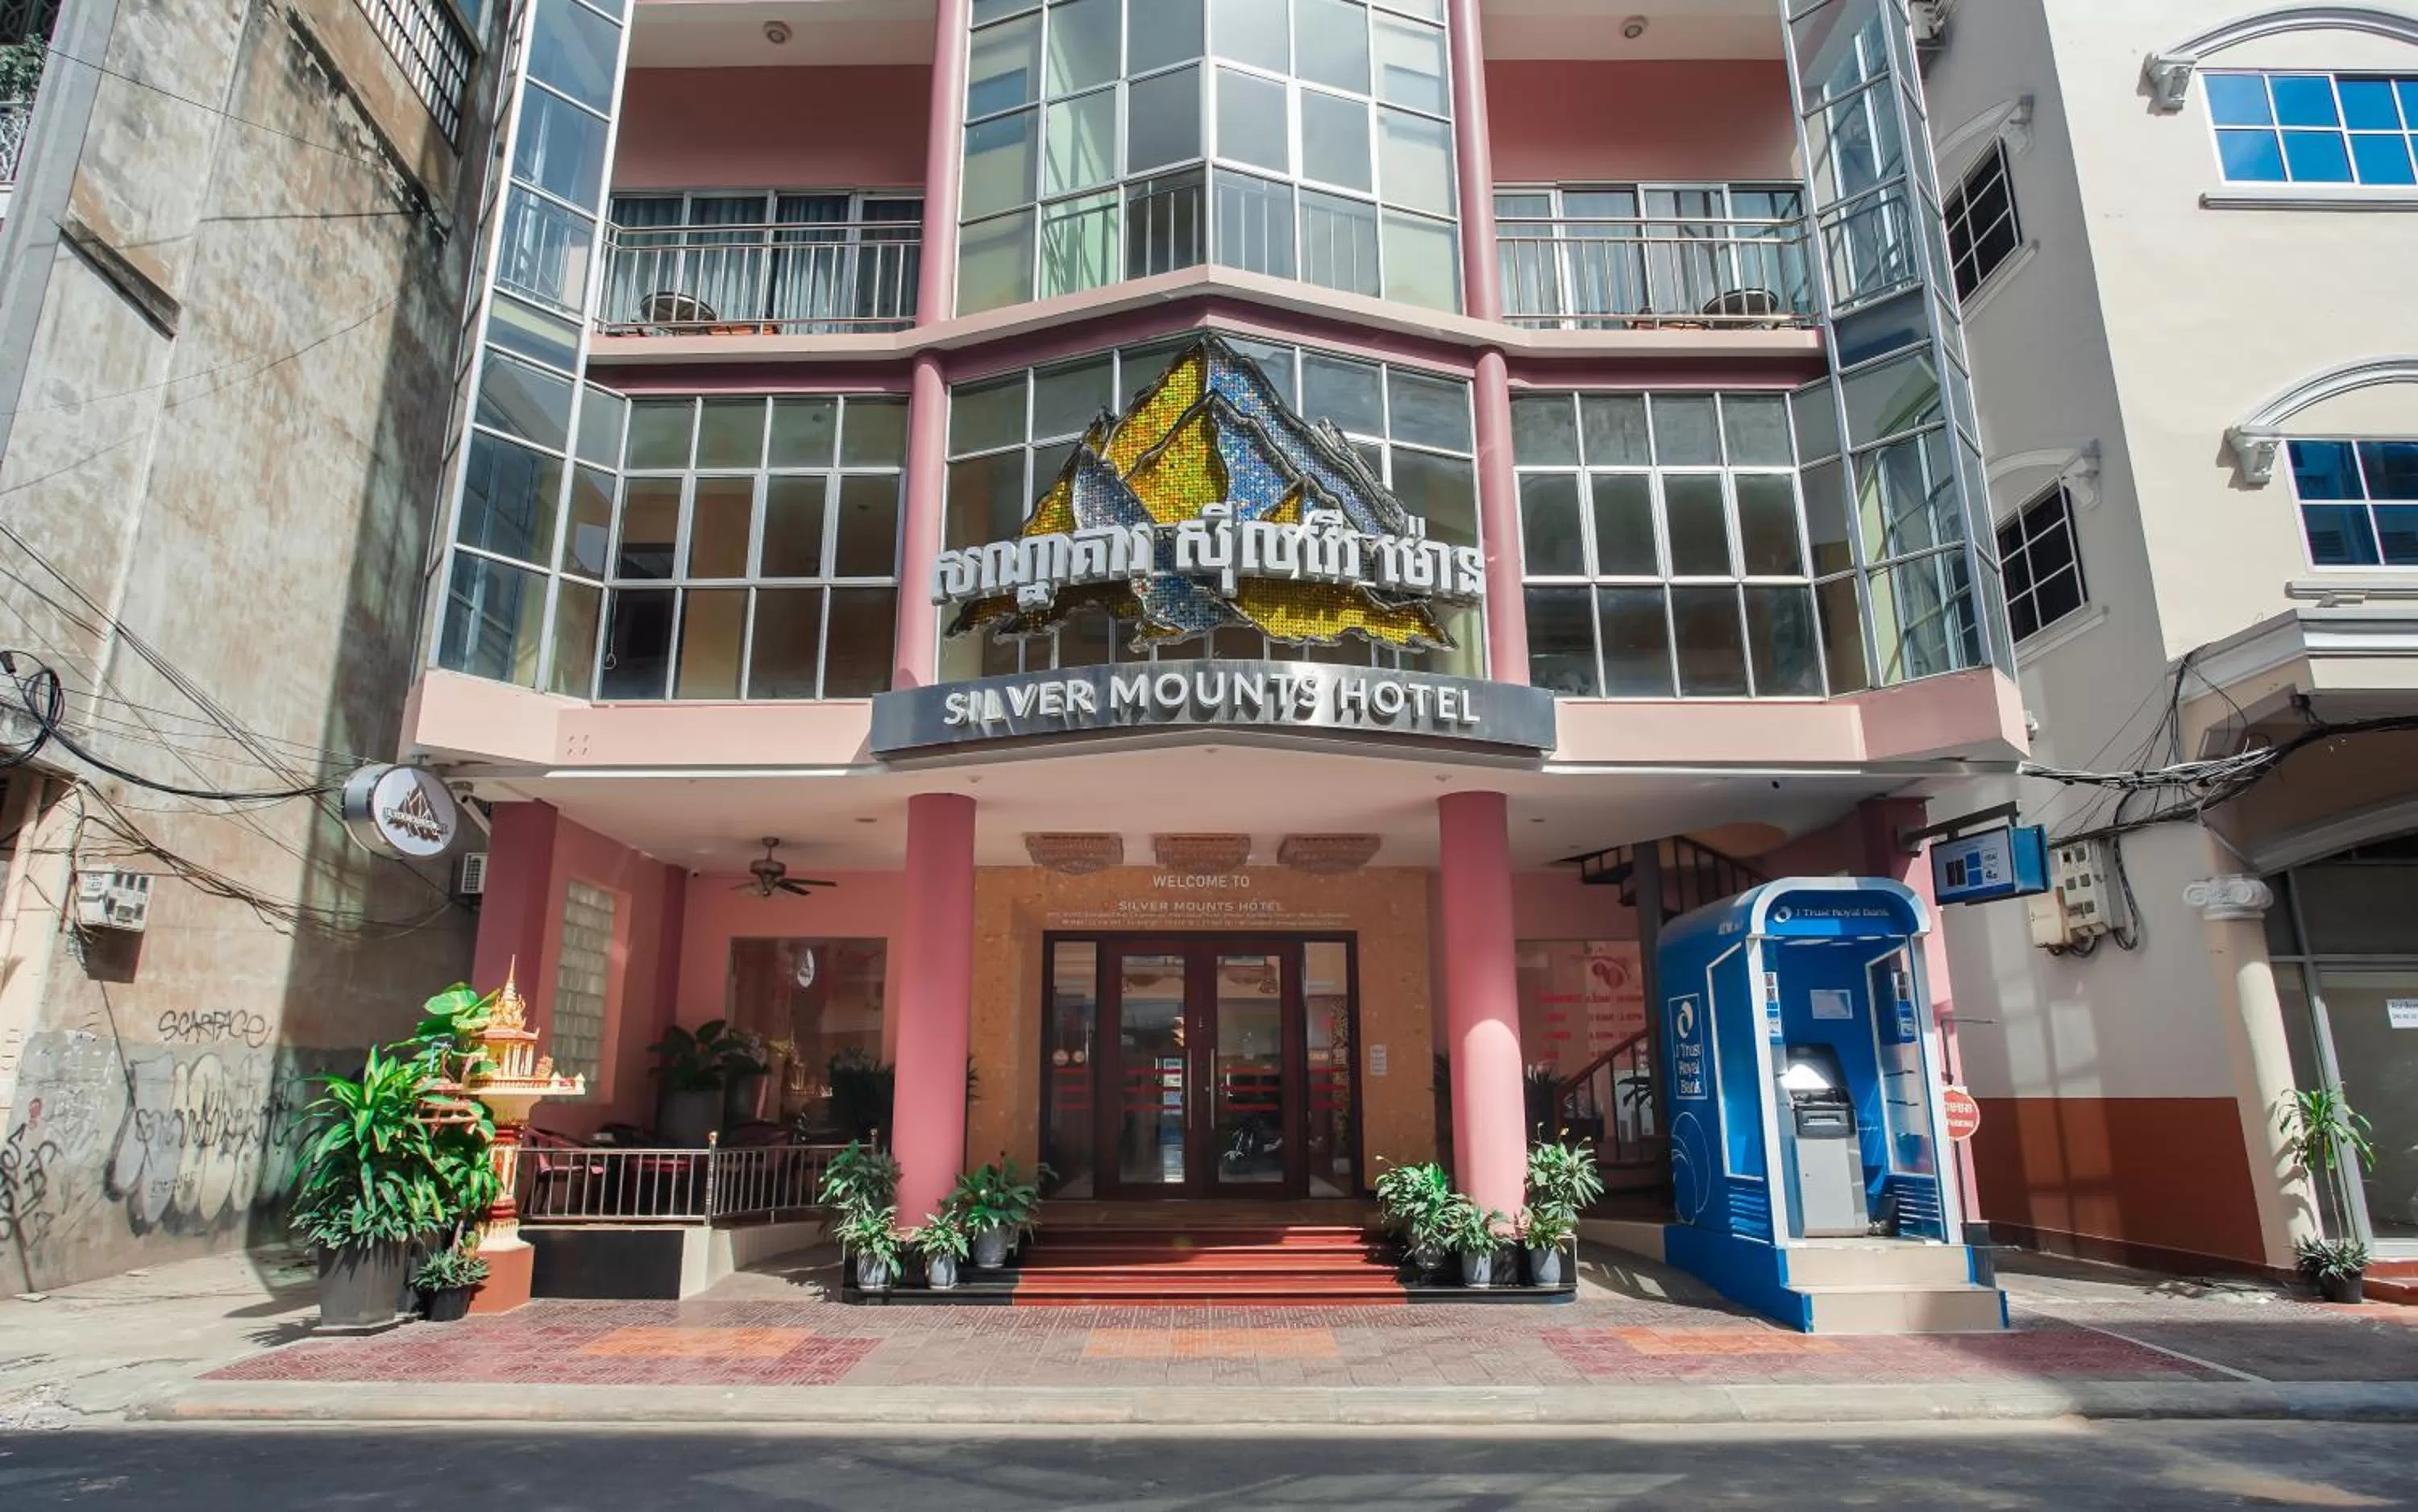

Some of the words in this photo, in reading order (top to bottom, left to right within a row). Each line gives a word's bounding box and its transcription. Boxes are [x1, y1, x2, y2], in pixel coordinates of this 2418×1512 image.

[944, 679, 1097, 725] SILVER
[1110, 671, 1319, 709] MOUNTS
[1340, 676, 1481, 724] HOTEL
[1153, 875, 1226, 888] WELCOME
[1232, 875, 1251, 888] TO
[1118, 901, 1169, 912] SILVER
[1174, 901, 1233, 912] MOUNTS
[1239, 901, 1285, 912] HOTEL
[1802, 908, 1830, 916] Trust
[1832, 908, 1861, 918] Royal
